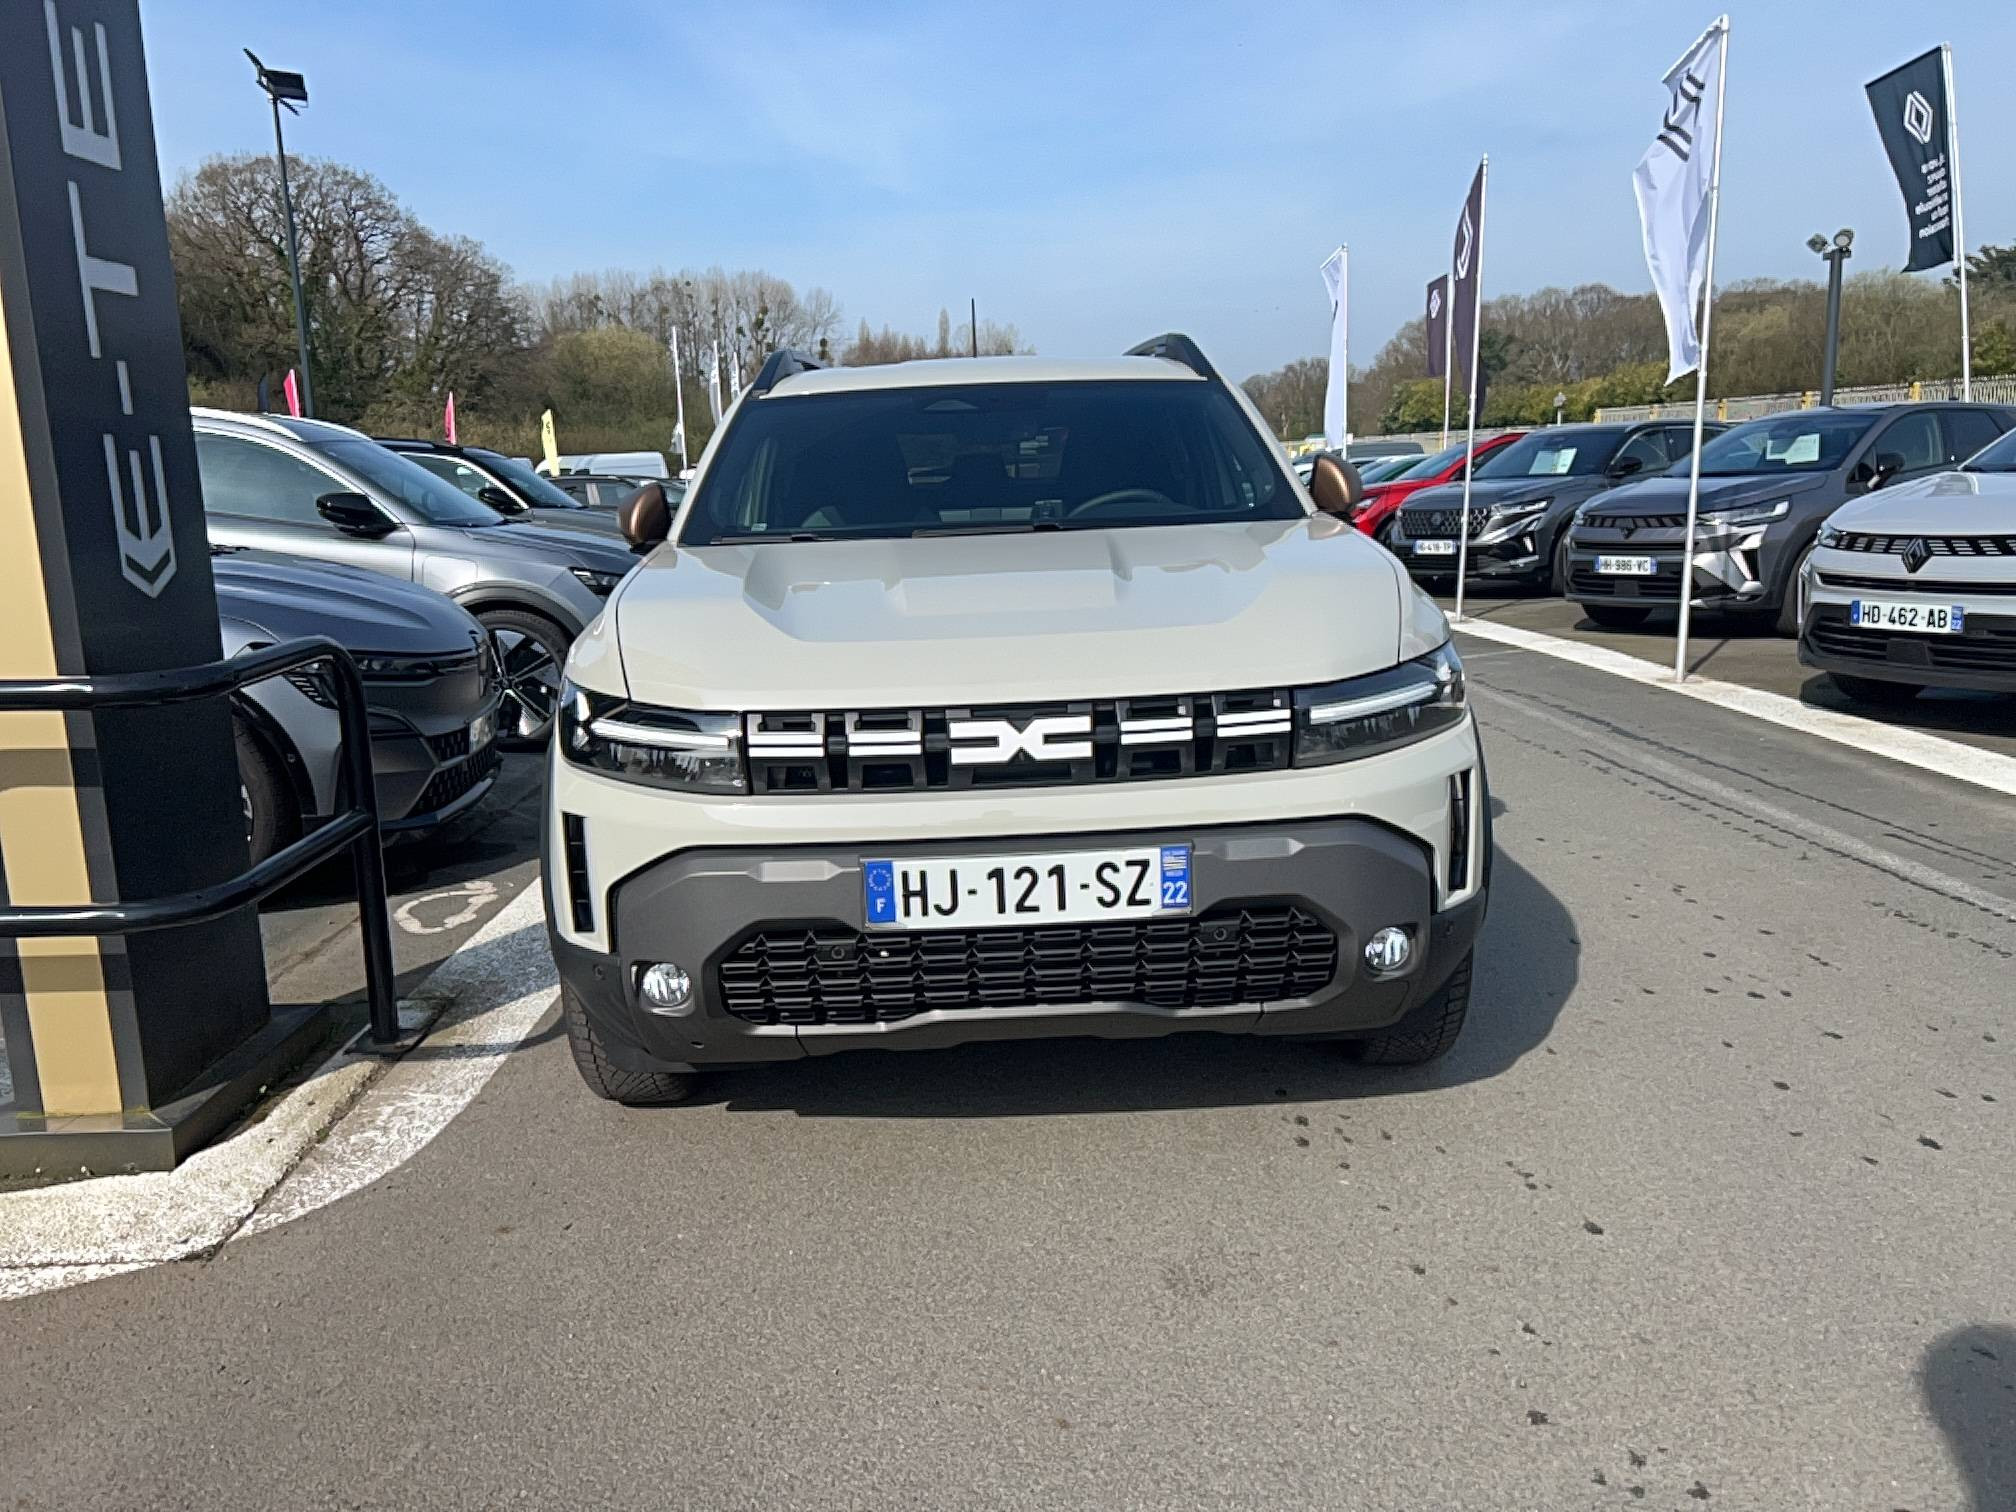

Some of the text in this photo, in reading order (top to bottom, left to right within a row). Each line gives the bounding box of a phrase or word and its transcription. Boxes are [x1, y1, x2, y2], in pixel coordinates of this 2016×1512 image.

[1862, 604, 1948, 629] HD-462-AB
[901, 859, 1152, 917] HJ-121-SZ
[1163, 881, 1188, 904] 22
[876, 898, 886, 913] F
